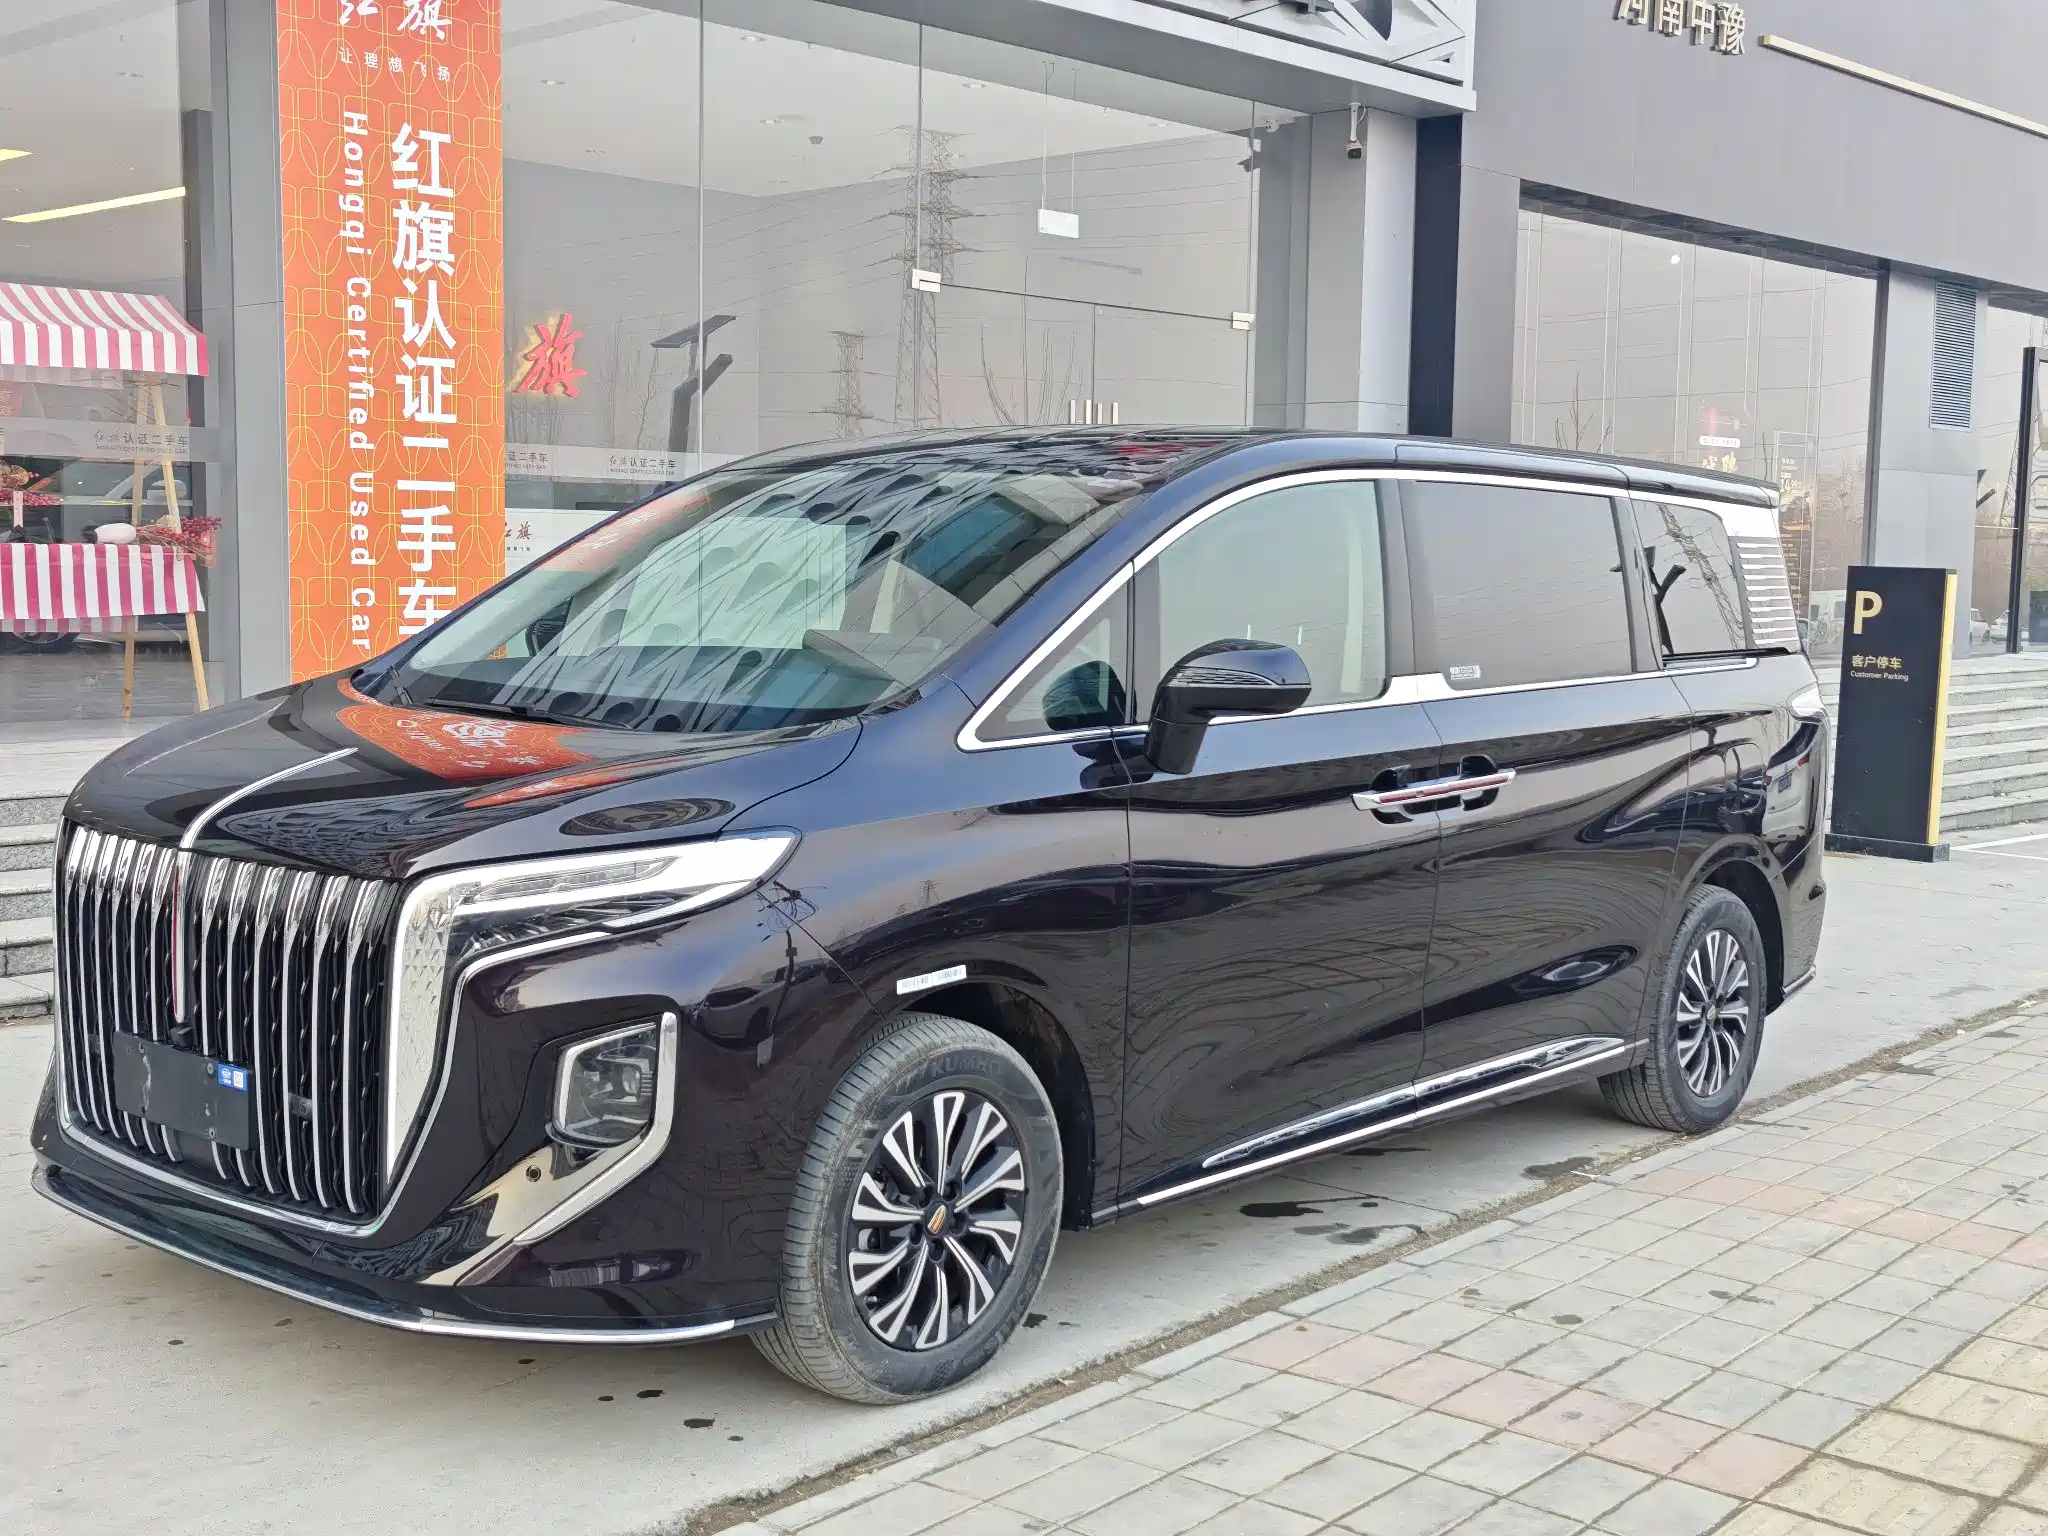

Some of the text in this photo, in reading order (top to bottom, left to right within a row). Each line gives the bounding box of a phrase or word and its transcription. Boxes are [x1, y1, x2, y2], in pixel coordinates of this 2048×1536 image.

[339, 47, 450, 82] 让理想飞扬
[339, 111, 376, 650] Hongqi Certified Used Car
[391, 122, 457, 636] 红旗认证二手车
[1853, 590, 1883, 635] P
[1850, 670, 1909, 682] Customer Parking
[1851, 654, 1902, 669] 客户停车
